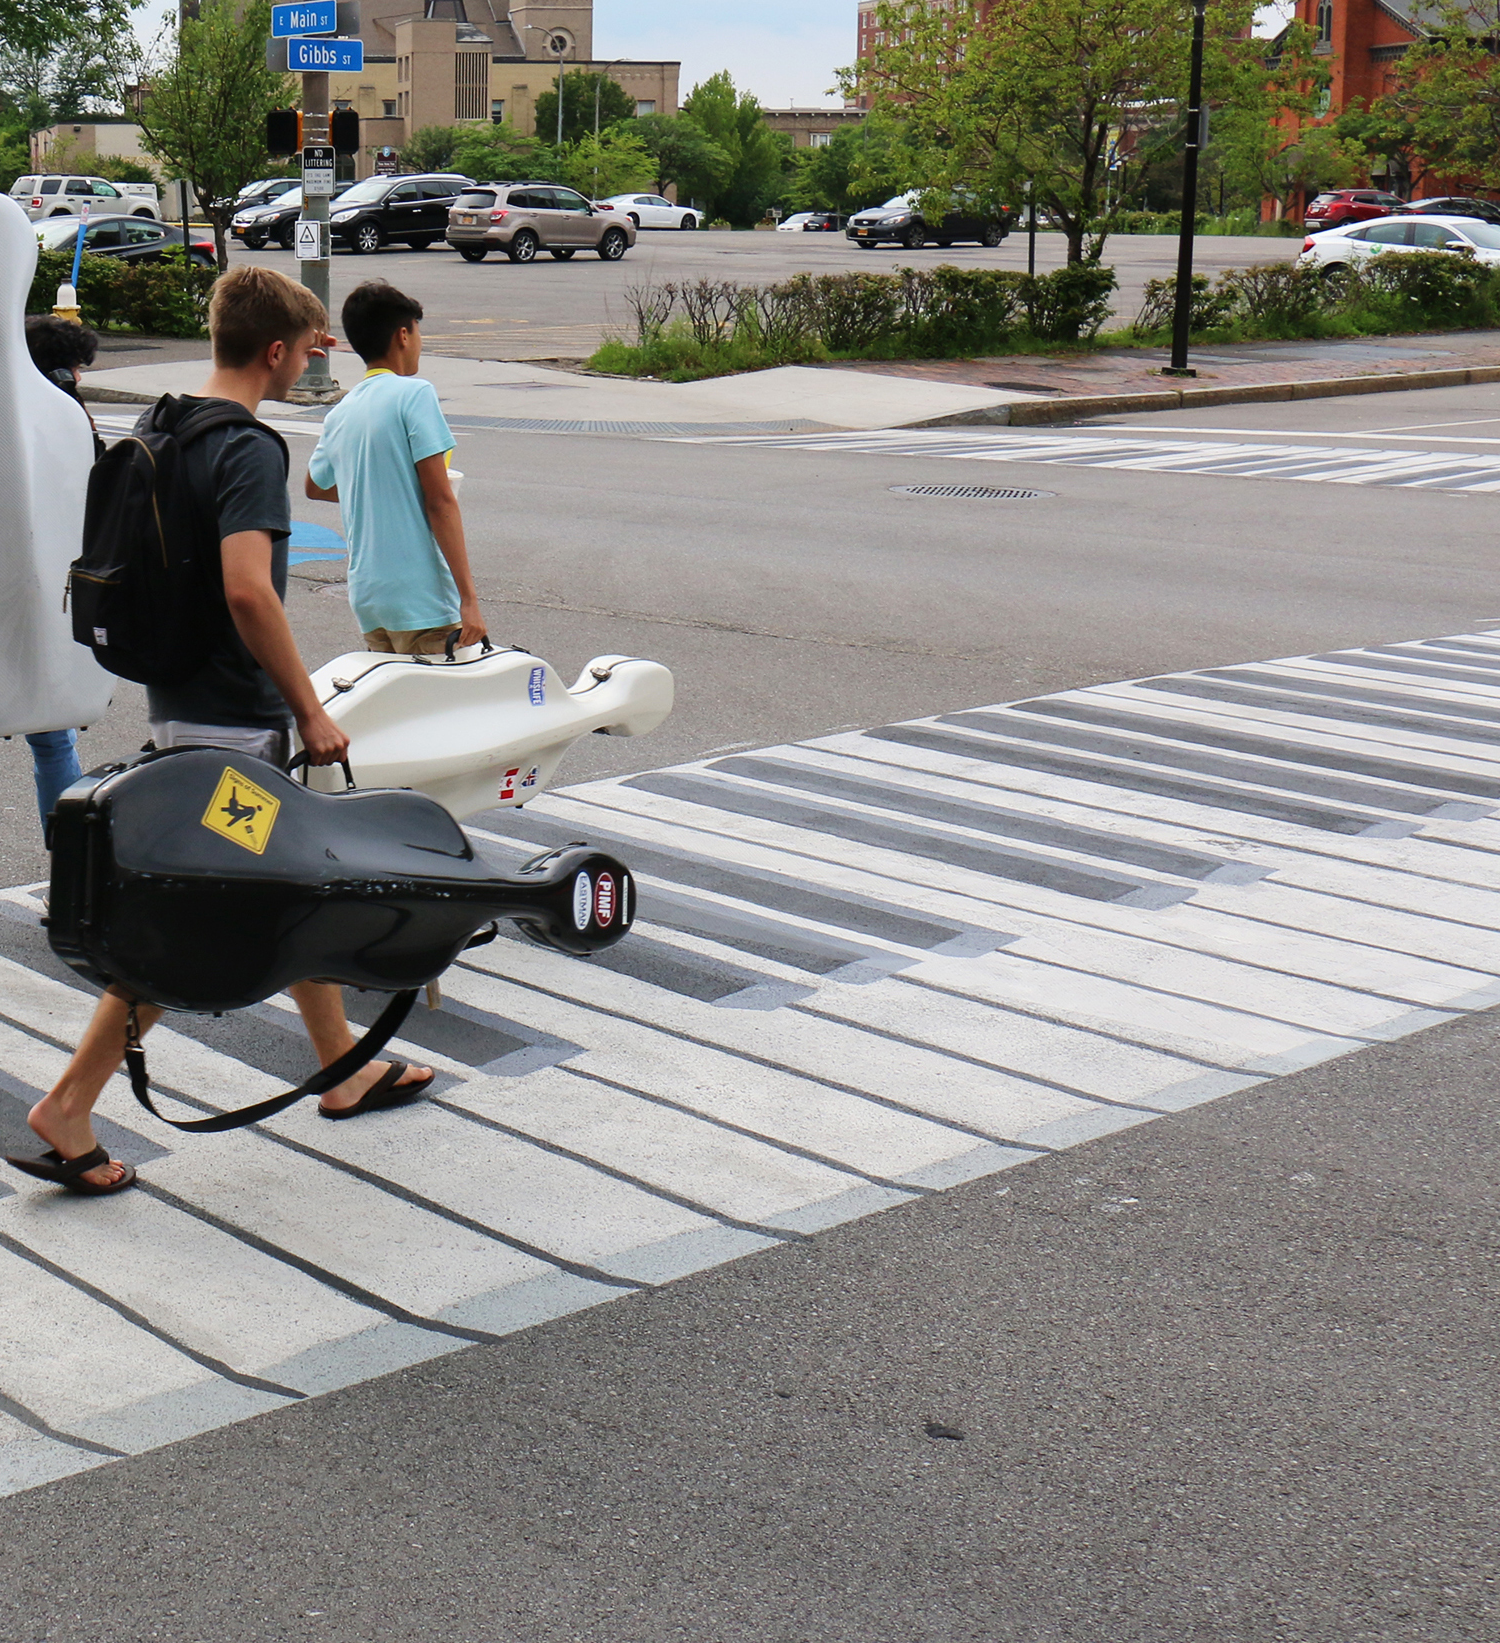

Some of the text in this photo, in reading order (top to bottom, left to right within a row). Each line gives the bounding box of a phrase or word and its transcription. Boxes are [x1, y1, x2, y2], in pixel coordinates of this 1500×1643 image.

[279, 9, 328, 29] E Main ST
[299, 44, 351, 65] Gibbs ST
[305, 158, 333, 167] LITTERING
[314, 149, 324, 158] NO
[579, 875, 588, 927] EASTMAN
[597, 880, 612, 919] PIMF
